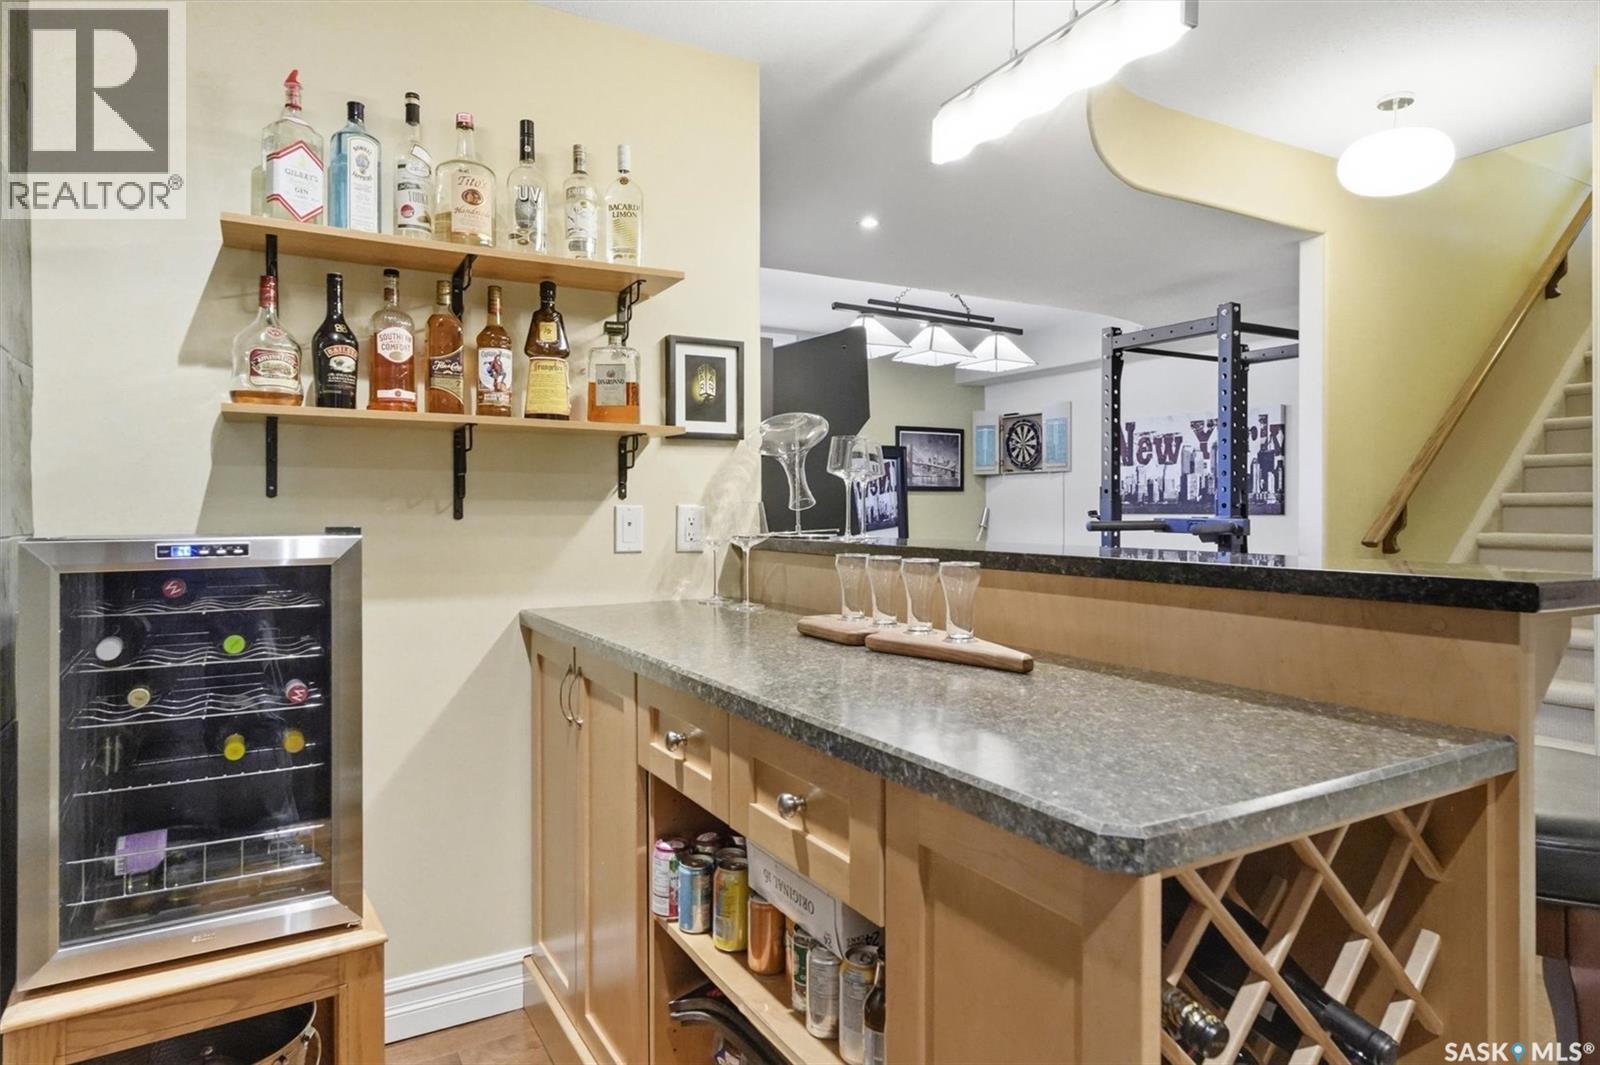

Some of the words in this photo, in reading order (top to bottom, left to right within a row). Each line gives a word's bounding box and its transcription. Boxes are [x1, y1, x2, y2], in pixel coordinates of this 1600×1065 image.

[294, 186, 309, 196] GIN
[519, 185, 542, 205] UV
[773, 876, 815, 916] ORIGINAL
